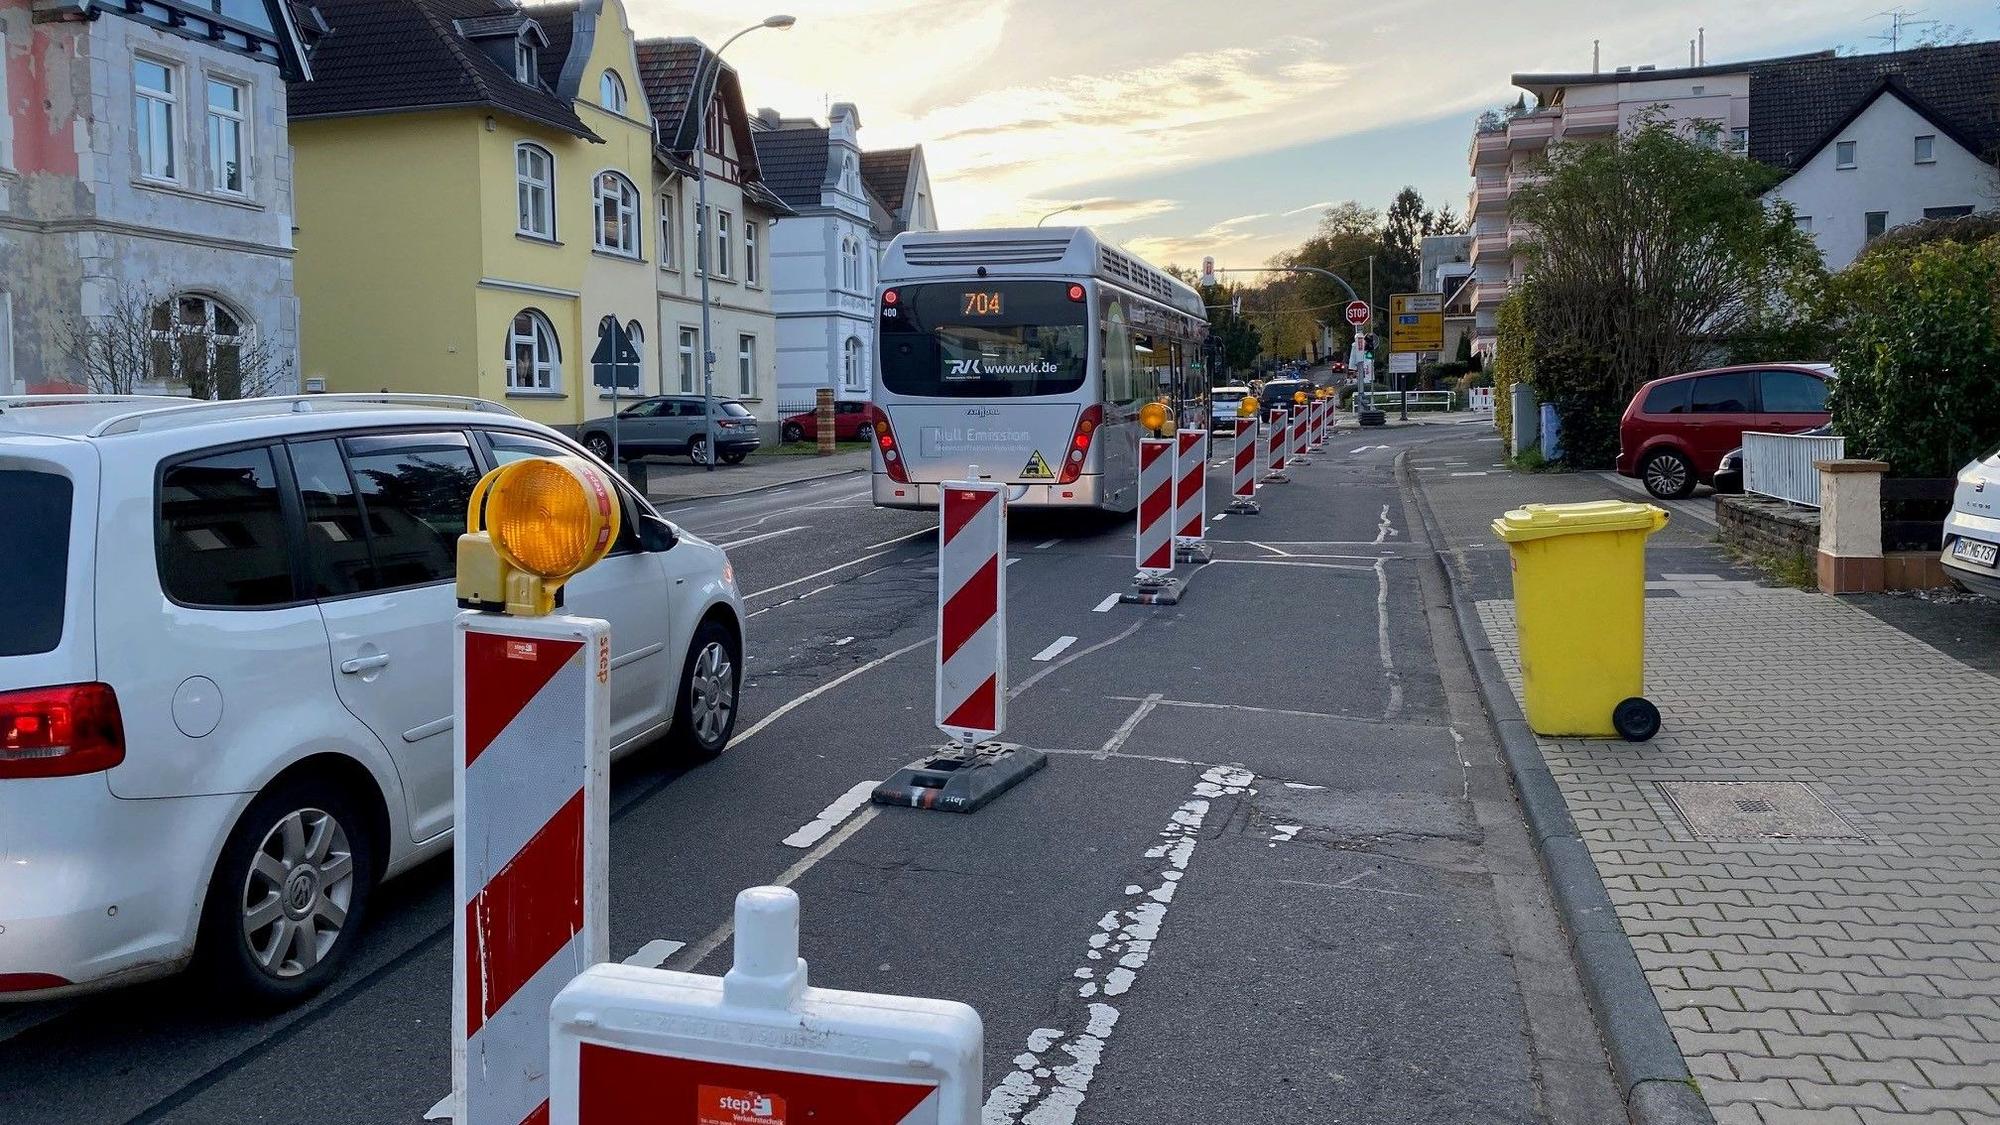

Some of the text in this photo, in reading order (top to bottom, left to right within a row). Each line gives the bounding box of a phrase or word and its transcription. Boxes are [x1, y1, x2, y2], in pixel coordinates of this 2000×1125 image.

[964, 292, 1000, 315] 704
[883, 308, 897, 318] 400
[1348, 308, 1367, 318] STOP
[984, 362, 1057, 374] www.rvk.de
[934, 428, 1030, 442] Null Emission
[1980, 545, 1996, 561] 737
[597, 636, 609, 684] step
[719, 1096, 751, 1114] step
